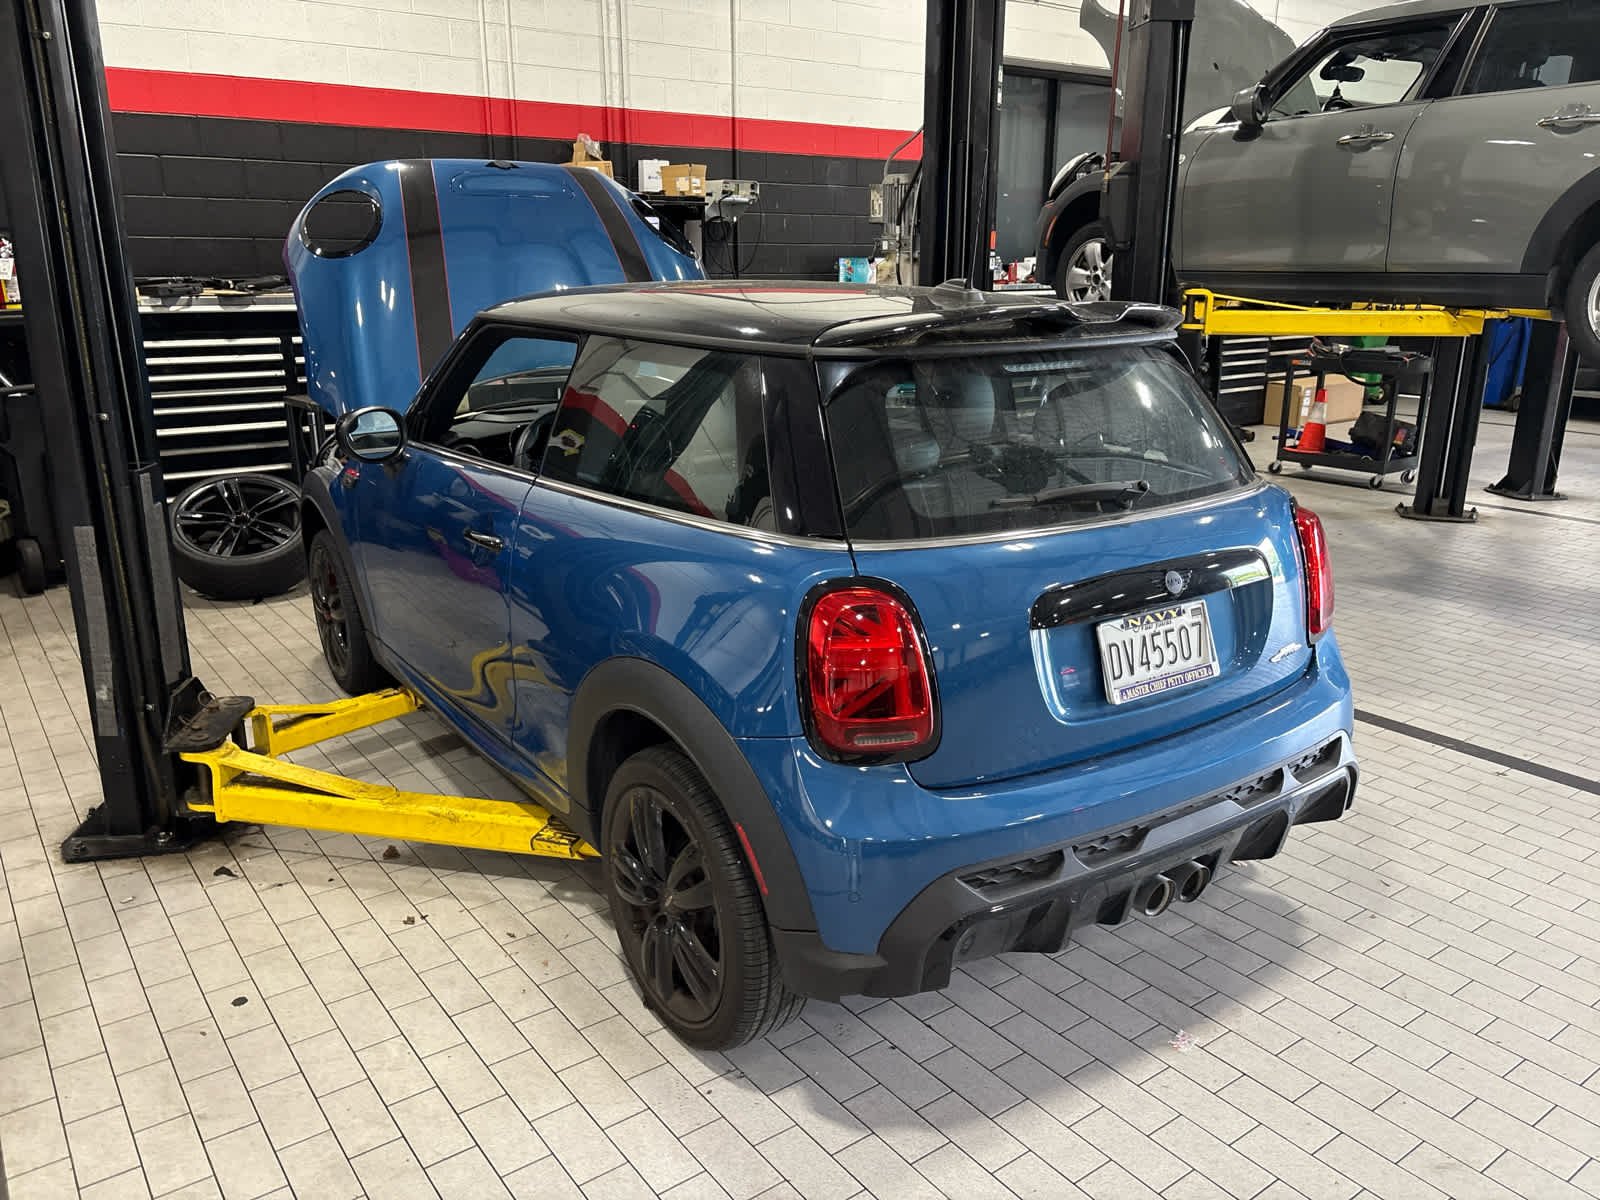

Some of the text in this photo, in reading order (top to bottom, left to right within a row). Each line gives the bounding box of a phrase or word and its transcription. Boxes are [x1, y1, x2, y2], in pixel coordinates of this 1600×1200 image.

[1127, 607, 1181, 627] NAVY
[1108, 621, 1202, 681] DV45507
[1126, 684, 1150, 700] MASTER
[1150, 679, 1167, 693] CHIEF
[1167, 675, 1185, 688] PETTY
[1185, 667, 1208, 683] OFFICER
